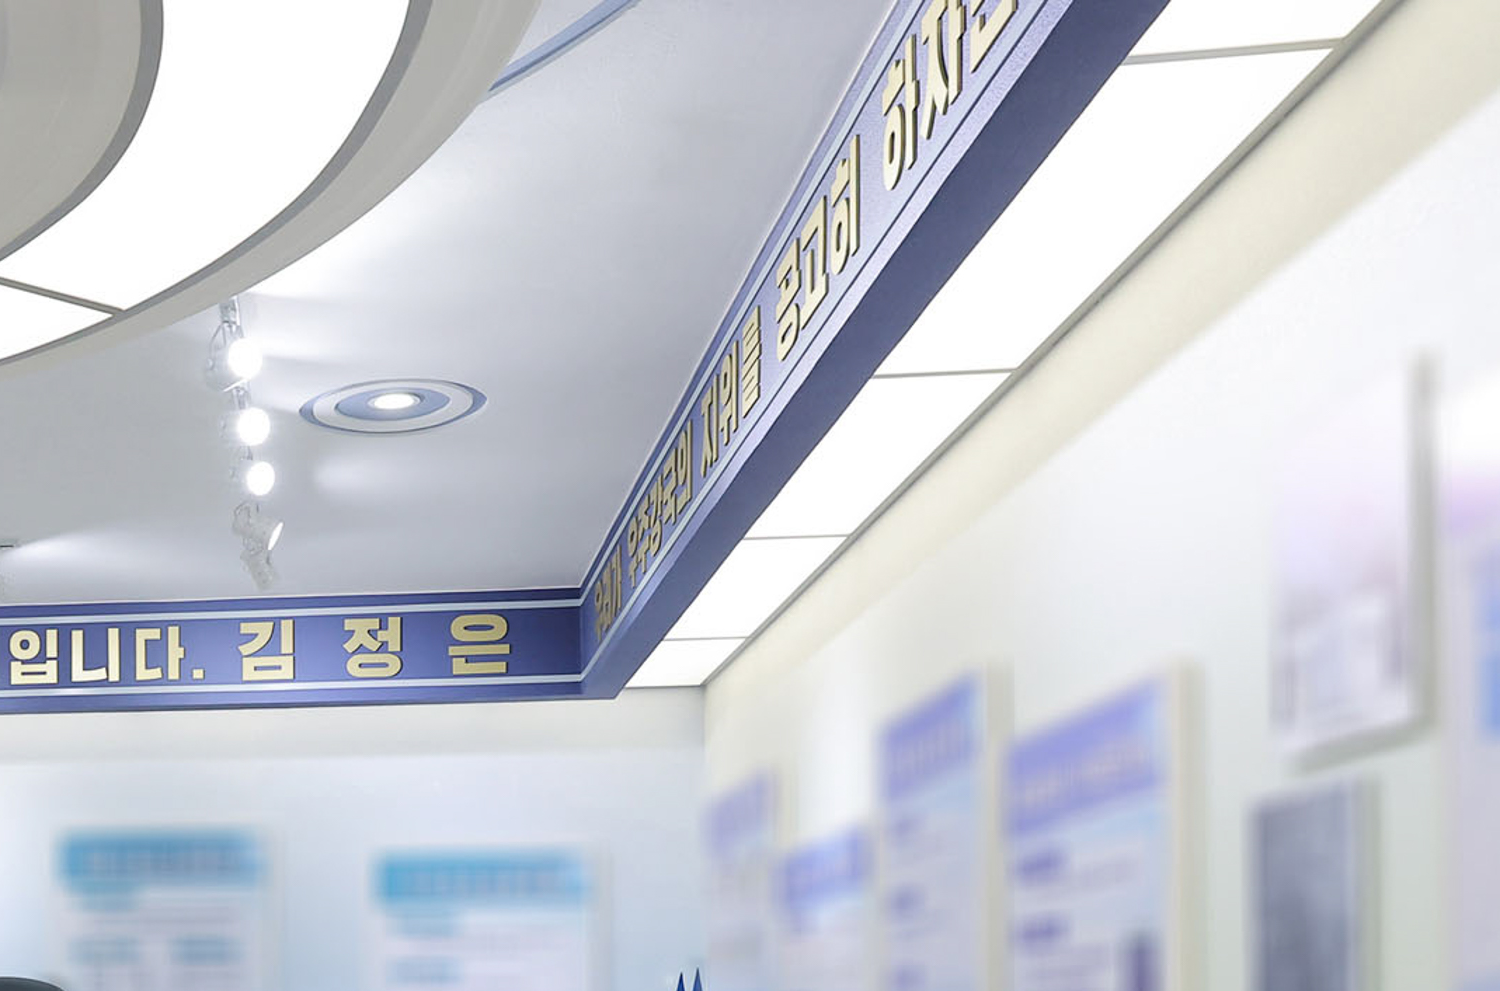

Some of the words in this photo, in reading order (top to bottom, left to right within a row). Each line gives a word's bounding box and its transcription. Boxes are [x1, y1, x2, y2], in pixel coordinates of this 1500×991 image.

[628, 420, 693, 588] 우주강국의
[701, 304, 762, 478] 지위를
[776, 134, 861, 362] 공고히
[238, 618, 296, 677] 김
[342, 615, 403, 678] 정
[448, 613, 512, 676] 은
